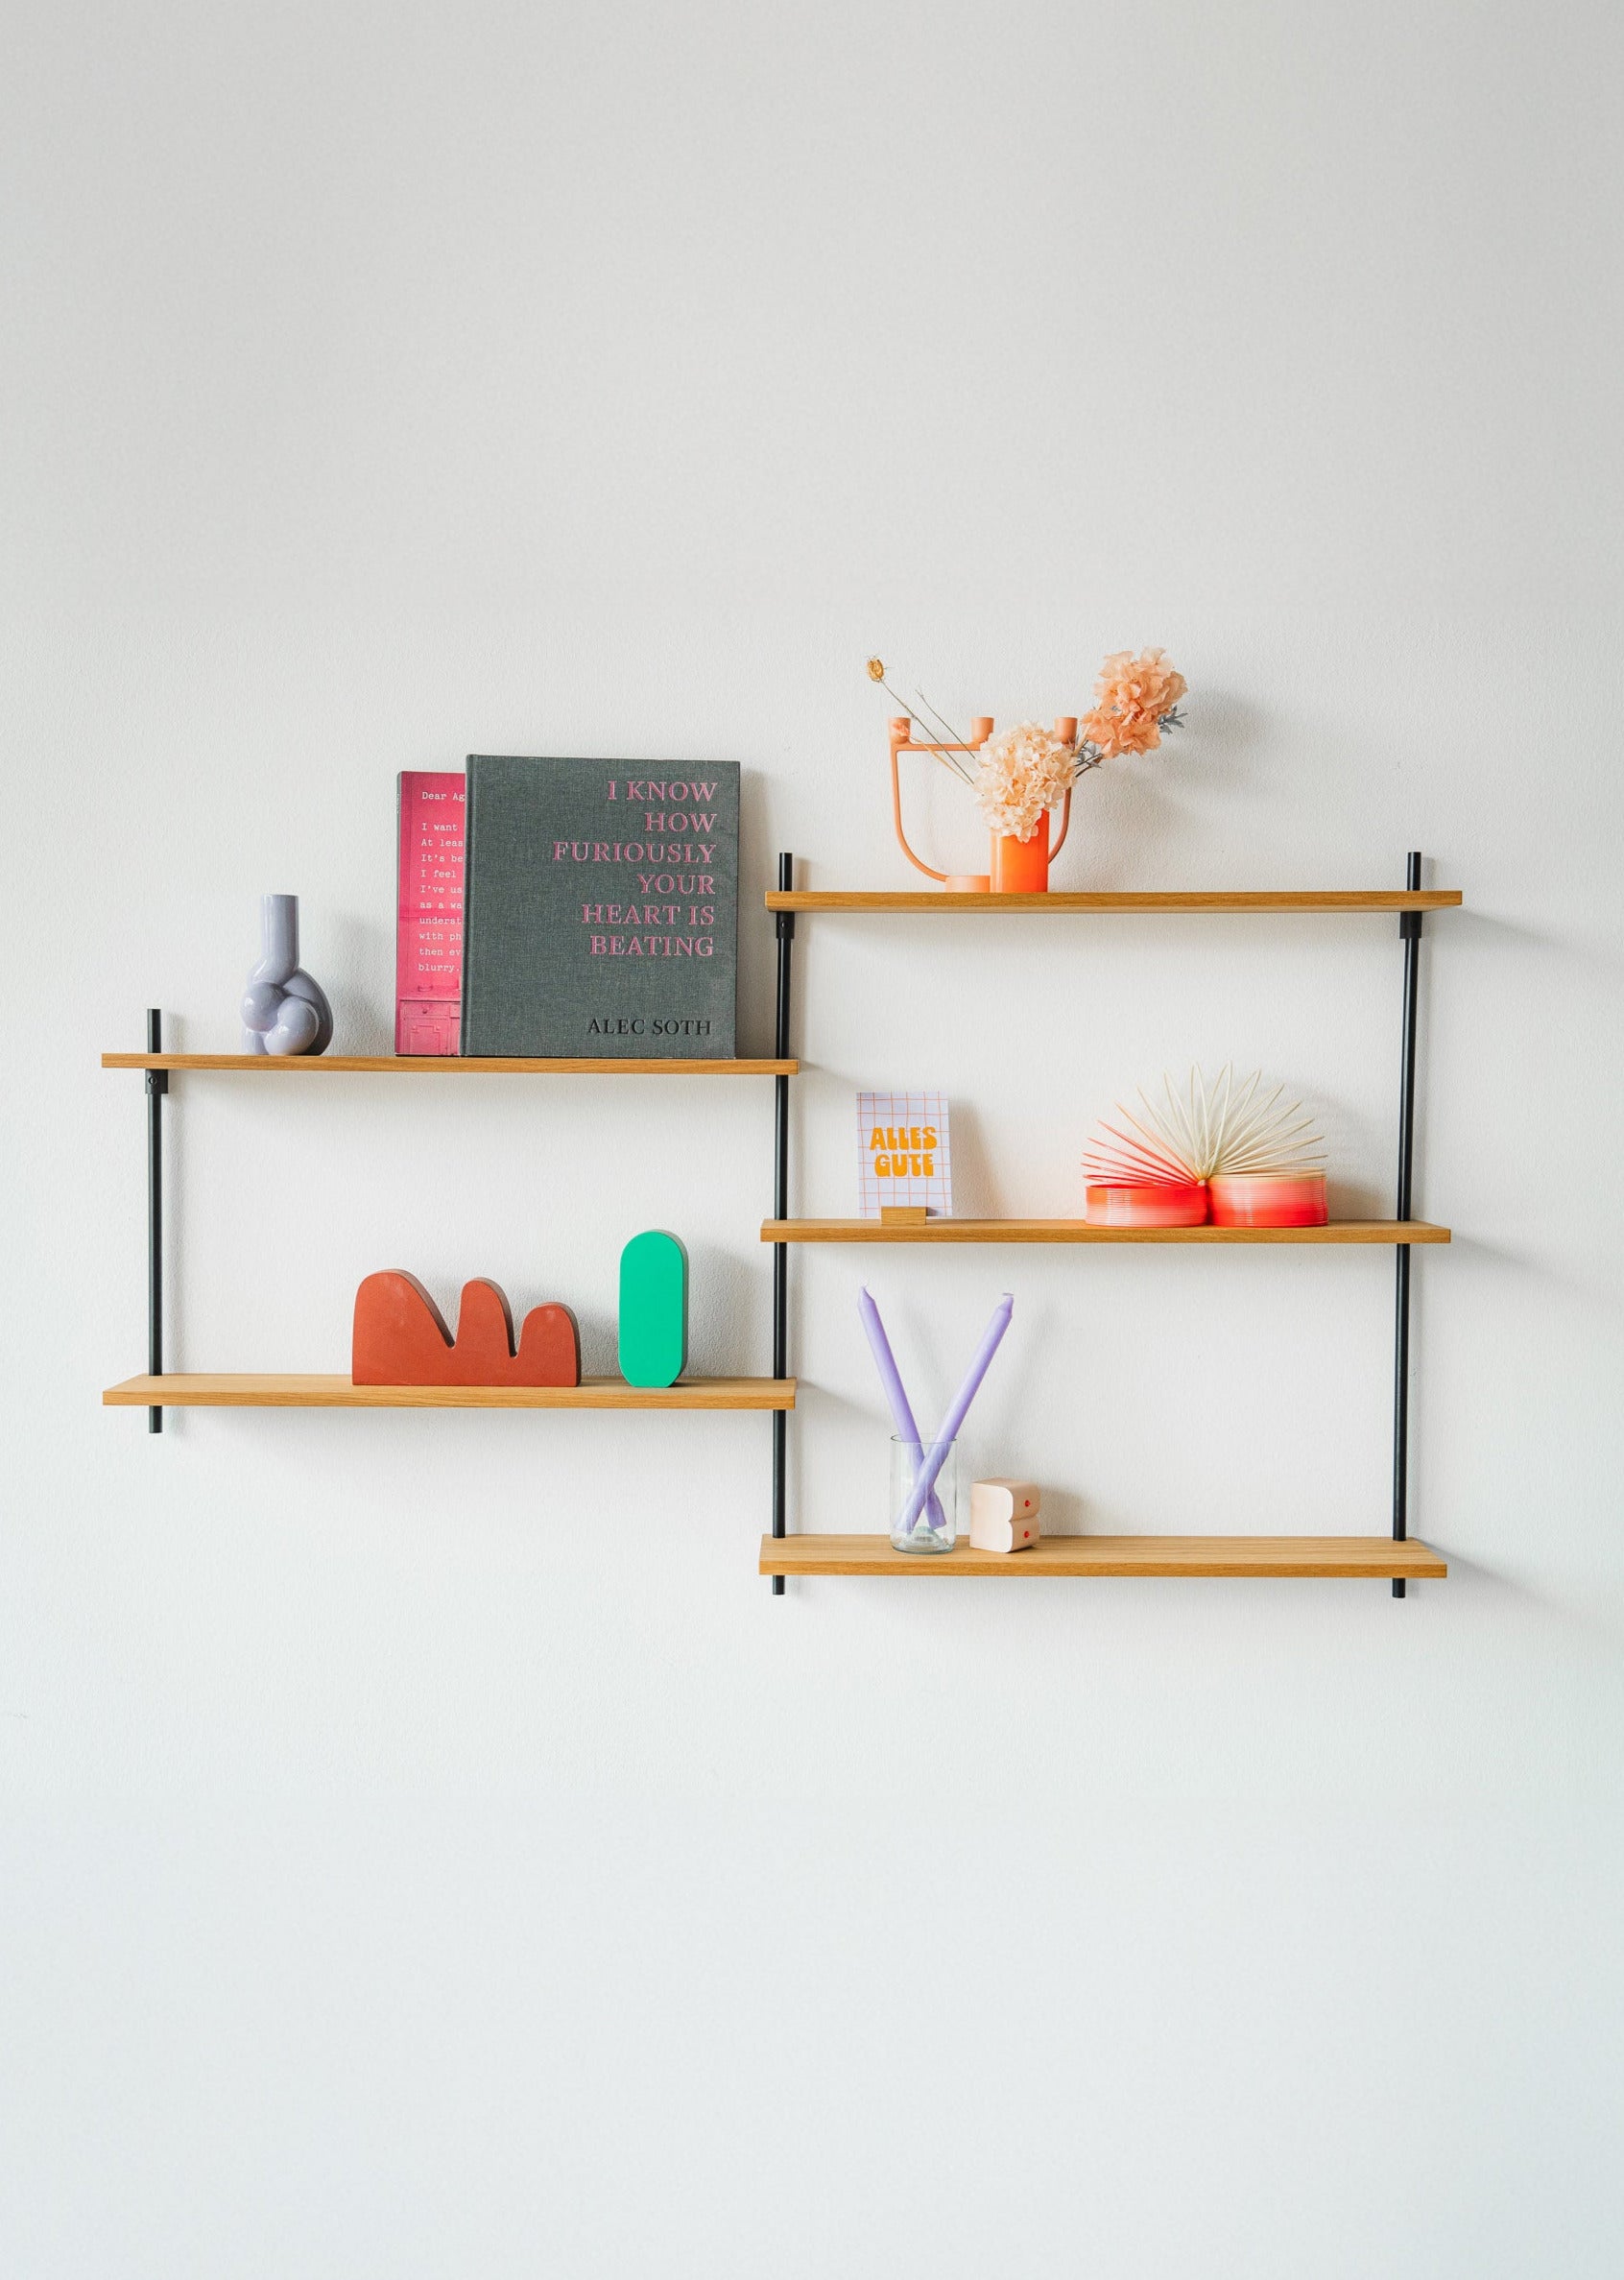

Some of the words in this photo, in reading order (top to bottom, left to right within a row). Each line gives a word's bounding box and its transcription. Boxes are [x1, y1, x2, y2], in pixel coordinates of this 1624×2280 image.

[421, 791, 447, 800] Dear
[452, 792, 466, 803] Ag
[608, 780, 618, 801] I
[626, 780, 718, 803] KNOW
[421, 823, 428, 831] I
[644, 812, 718, 833] HOW
[420, 838, 433, 847] At
[441, 838, 464, 847] leas
[420, 853, 445, 862] It's
[552, 841, 717, 865] FURIOUSLY
[433, 869, 457, 878] feel
[420, 884, 445, 894] I've
[636, 874, 716, 896] YOUR
[581, 903, 681, 925] HEART
[688, 905, 715, 926] IS
[449, 932, 462, 942] ph
[418, 948, 443, 956] then
[589, 935, 714, 957] BEATING
[418, 963, 460, 973] blurry.
[587, 1018, 645, 1035] ALEC
[653, 1020, 711, 1036] SOTH
[870, 1126, 938, 1151] ALLES
[874, 1153, 934, 1177] GUTE
